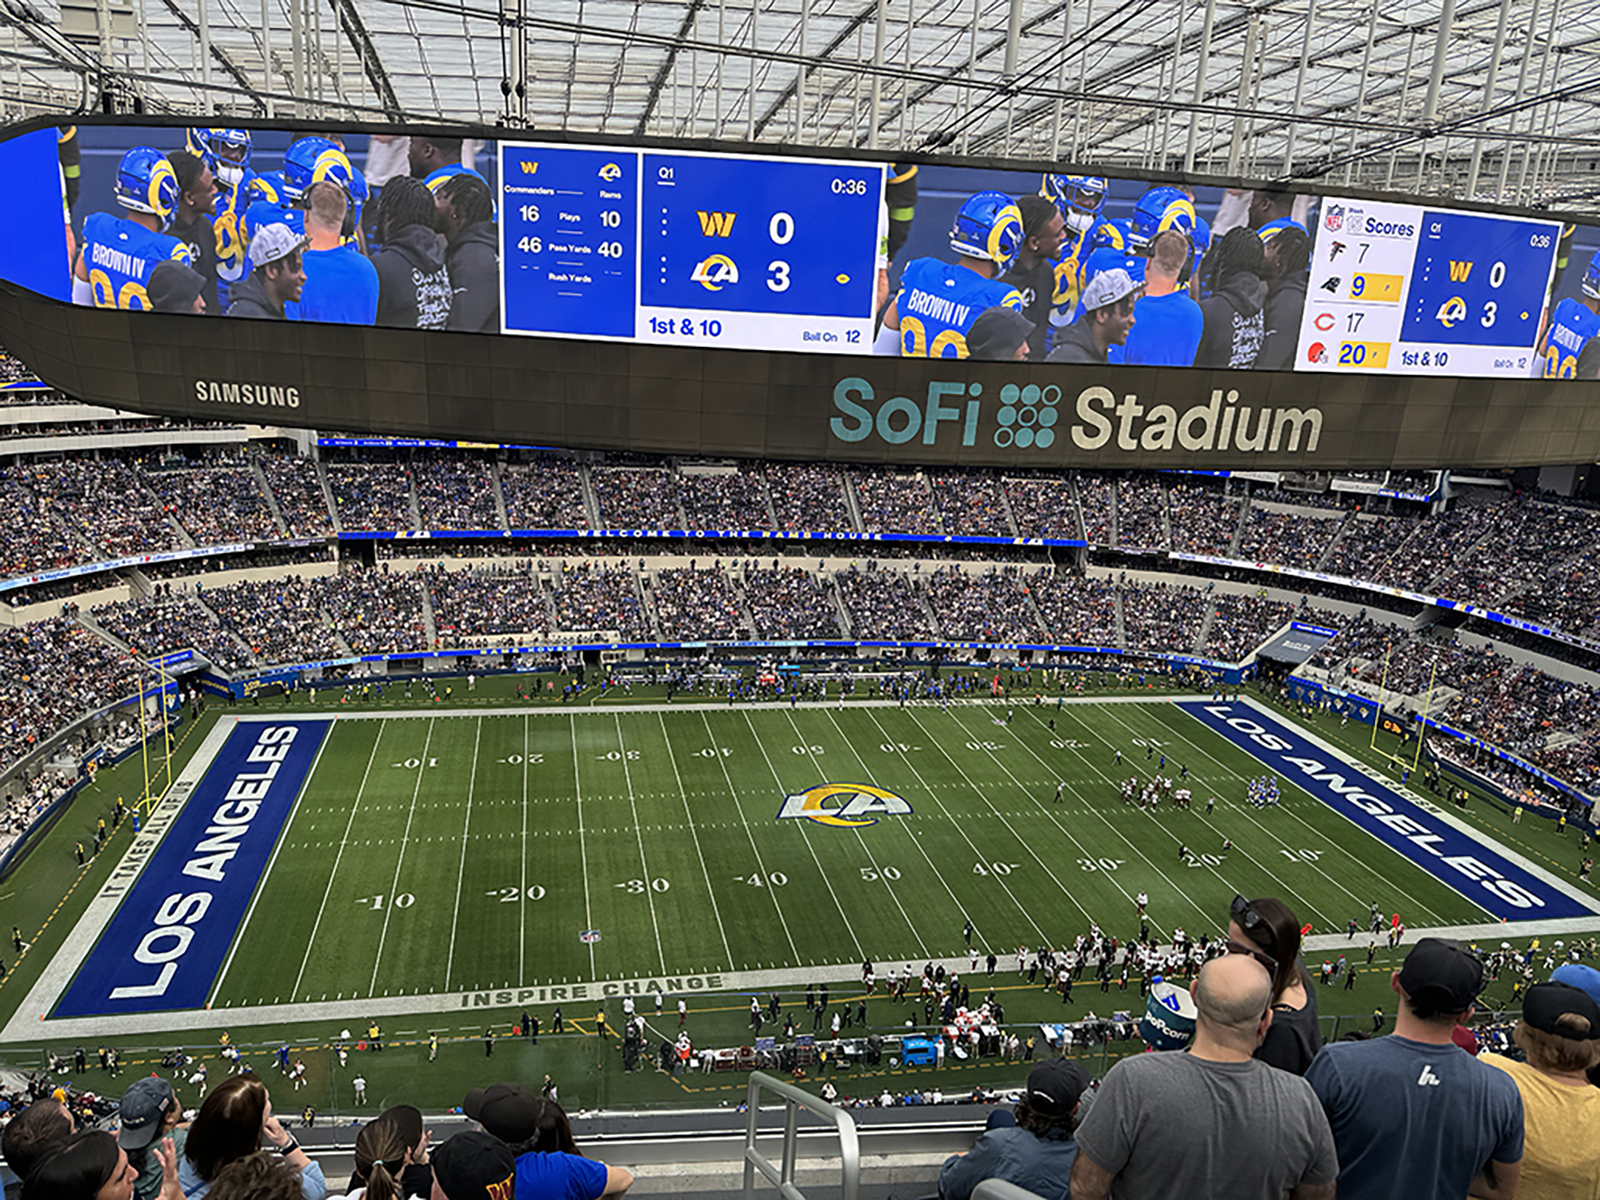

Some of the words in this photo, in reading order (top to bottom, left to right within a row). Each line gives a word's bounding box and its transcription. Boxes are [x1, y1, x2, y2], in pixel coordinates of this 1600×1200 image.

[658, 166, 674, 180] Q1
[504, 184, 555, 196] Commanders
[600, 190, 622, 200] Rams
[831, 178, 867, 195] 0:36
[519, 205, 540, 222] 16
[600, 210, 621, 228] 10
[1365, 216, 1415, 237] Scores
[769, 212, 795, 245] 0
[518, 236, 542, 254] 46
[597, 241, 623, 259] 40
[1359, 242, 1371, 264] 7
[92, 241, 132, 276] BROWN
[131, 256, 146, 279] IV
[766, 260, 791, 292] 3
[1489, 261, 1507, 289] 0
[1352, 275, 1366, 297] 9
[907, 288, 956, 323] BROWN
[951, 303, 971, 327] IV
[1481, 301, 1498, 329] 3
[648, 317, 676, 335] 1st
[680, 317, 694, 335] &
[699, 319, 722, 338] 10
[1346, 312, 1365, 333] 17
[802, 330, 821, 342] Ball
[822, 332, 838, 343] On
[845, 329, 861, 344] 12
[1338, 343, 1367, 365] 20
[1401, 350, 1419, 366] 1st
[1420, 351, 1431, 366] &
[1433, 352, 1449, 367] 10
[1517, 357, 1528, 370] 12
[195, 380, 301, 409] SAMSUNG
[829, 376, 984, 447] SoFi
[1071, 386, 1324, 453] Stadium
[577, 529, 670, 538] WELCOME
[683, 530, 705, 538] TO
[717, 530, 750, 538] THE
[762, 530, 812, 539] RAMS
[823, 531, 882, 540] HOUSE
[1202, 704, 1292, 752] LOS
[1282, 755, 1546, 909] ANGELES
[100, 885, 126, 898] IT
[113, 839, 155, 880] TAKES
[143, 814, 173, 835] ALL
[108, 891, 214, 1000] LOS
[182, 724, 299, 882] ANGELES
[1076, 857, 1120, 873] 30
[1280, 848, 1320, 862] 10
[746, 871, 789, 888] 40
[860, 866, 902, 882] 50
[972, 861, 1012, 877] 40
[499, 884, 546, 902] 20
[626, 878, 671, 895] 30
[368, 892, 416, 911] 10
[460, 985, 589, 1008] INSPIRE
[602, 975, 725, 997] CHANGE
